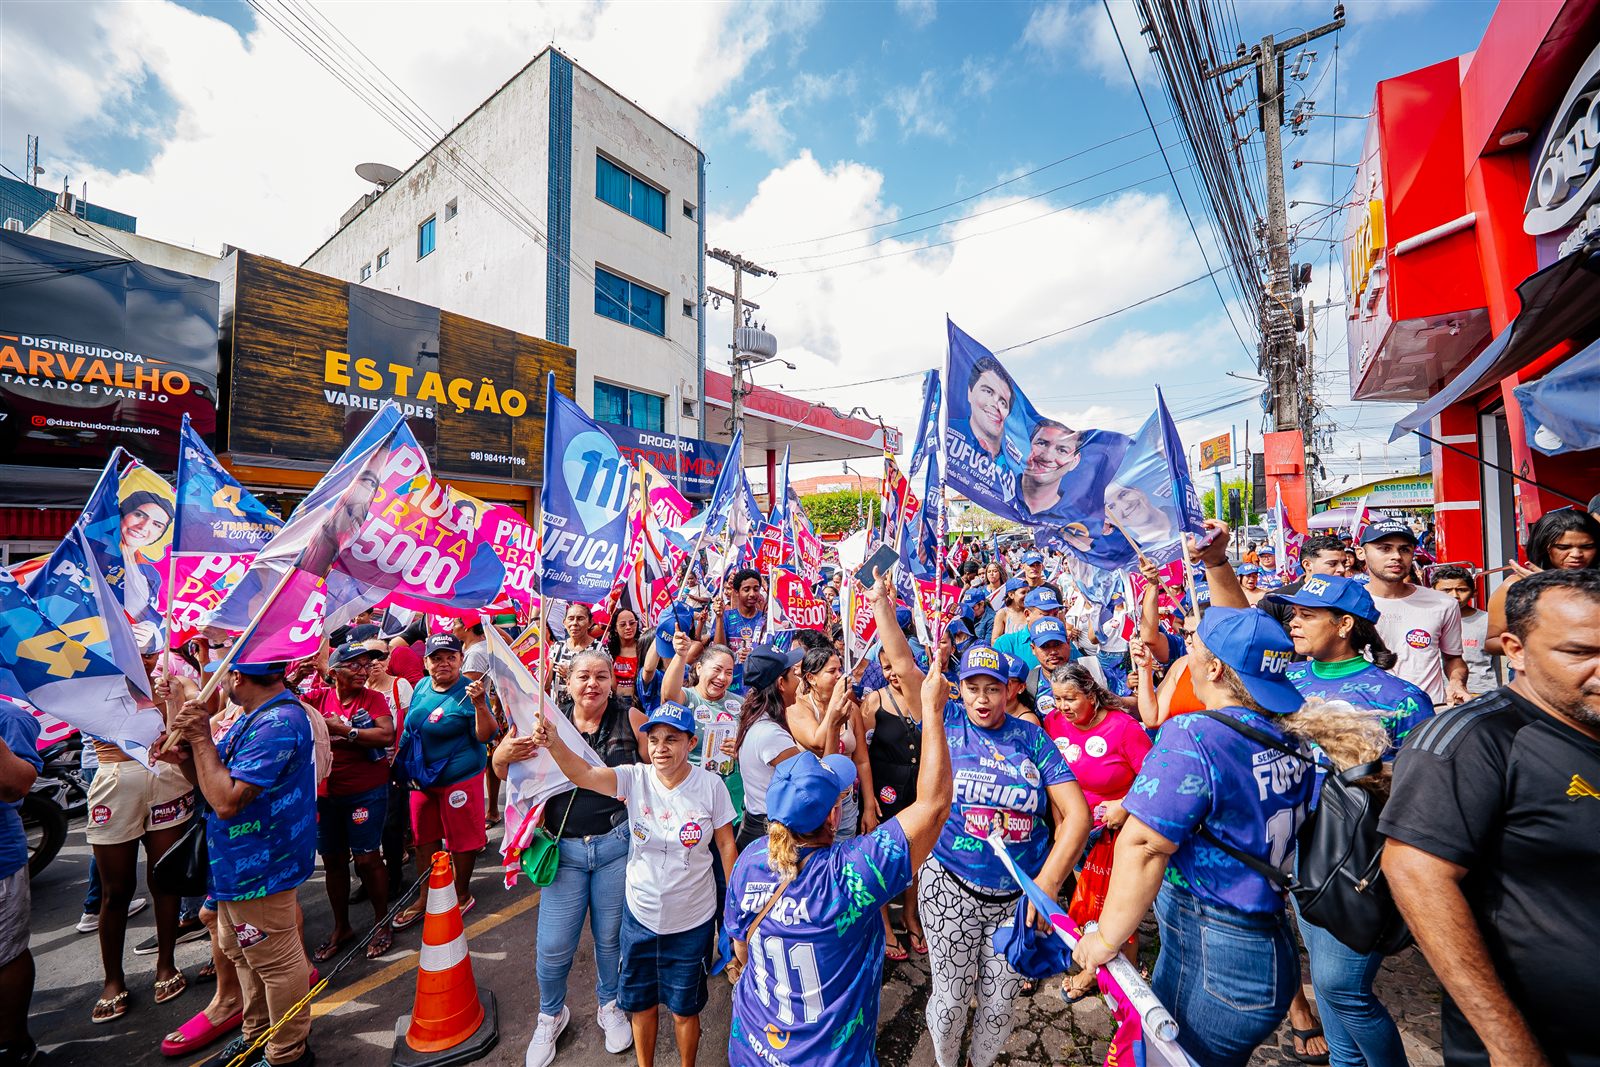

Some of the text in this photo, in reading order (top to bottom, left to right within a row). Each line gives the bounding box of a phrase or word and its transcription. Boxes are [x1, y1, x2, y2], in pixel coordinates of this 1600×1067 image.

[22, 336, 144, 364] DISTRIBUIDORA
[2, 373, 168, 404] TACADO E VAREJO
[324, 350, 528, 417] ESTAÇÃO
[46, 418, 160, 436] @distribuidoracarvalhofk
[638, 433, 694, 453] DROGARIA
[470, 452, 484, 462] 98)
[575, 450, 629, 512] 111
[1374, 482, 1428, 492] ASSOCIAÇÃO
[380, 445, 475, 544] PAULA
[545, 568, 609, 589] Fialho Sargento
[960, 772, 992, 781] SENADOR
[271, 788, 302, 816] BRA
[229, 820, 261, 840] BRA
[1008, 818, 1030, 831] 55000
[680, 830, 701, 840] 55000
[952, 836, 984, 853] BRA
[235, 849, 270, 874] BRA
